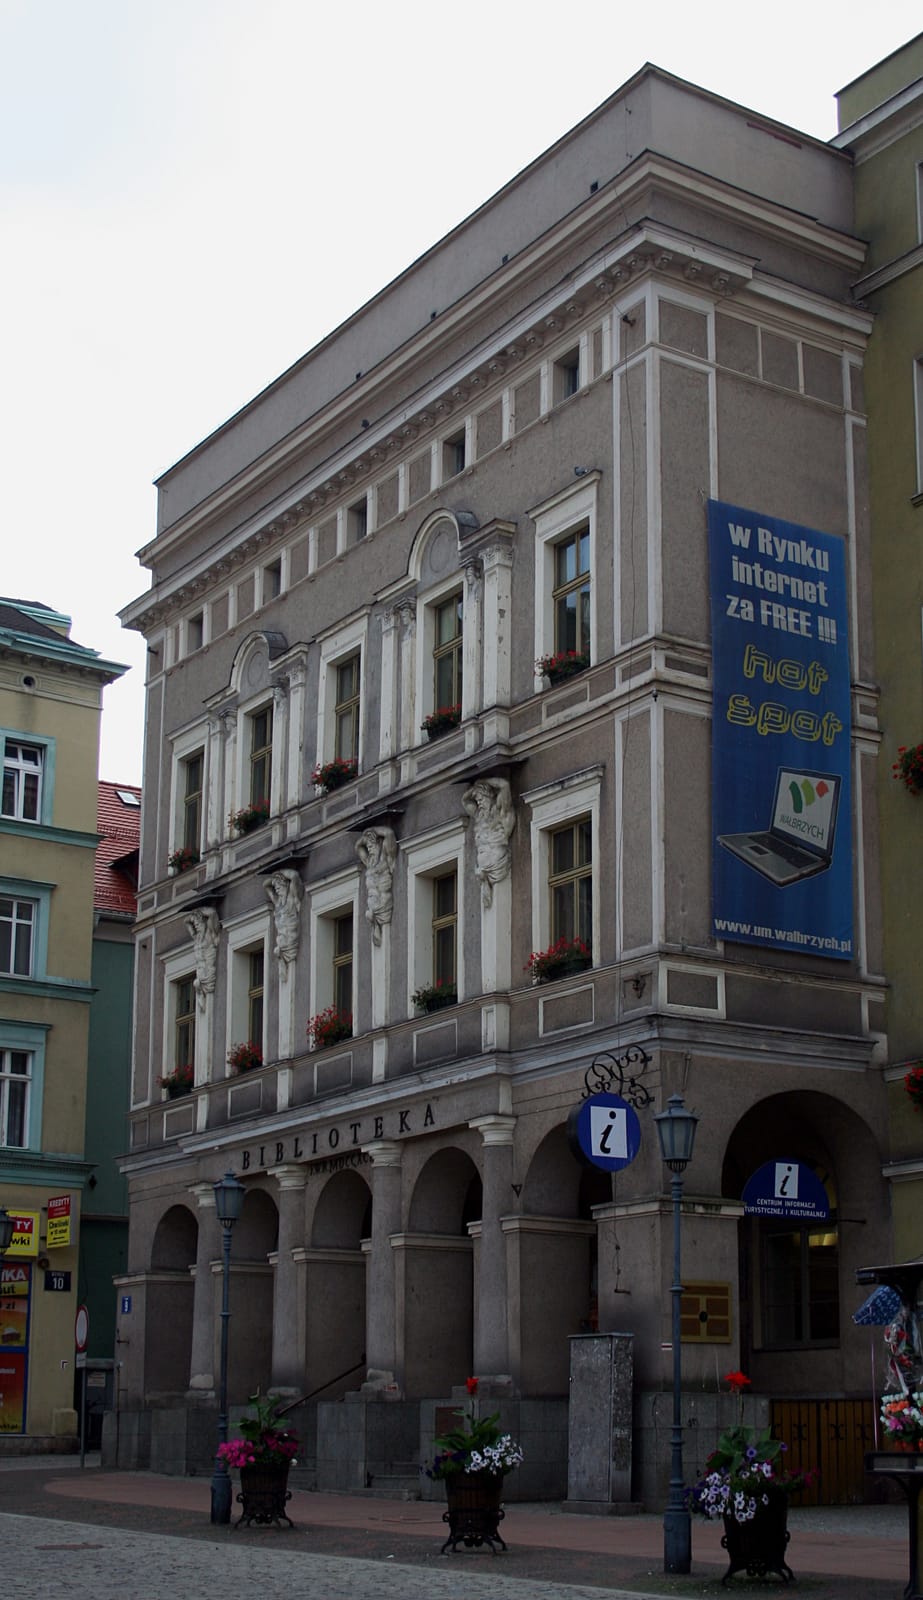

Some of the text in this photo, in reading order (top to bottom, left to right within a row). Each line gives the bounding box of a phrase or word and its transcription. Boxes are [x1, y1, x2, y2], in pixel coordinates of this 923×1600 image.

[727, 522, 830, 573] w Rynku
[731, 554, 829, 608] internet
[725, 594, 838, 646] za FREE !!!
[743, 644, 829, 695] hot
[726, 694, 843, 746] spot
[714, 918, 852, 953] www.um.walbrzych.pl
[241, 1103, 435, 1170] BIBLIOTEKA
[744, 1205, 784, 1215] TURYSTYCZNEJ
[789, 1208, 827, 1218] KULTURALNEJ
[756, 1198, 816, 1209] CENTRUM INFORMACJI
[52, 1277, 64, 1289] 10
